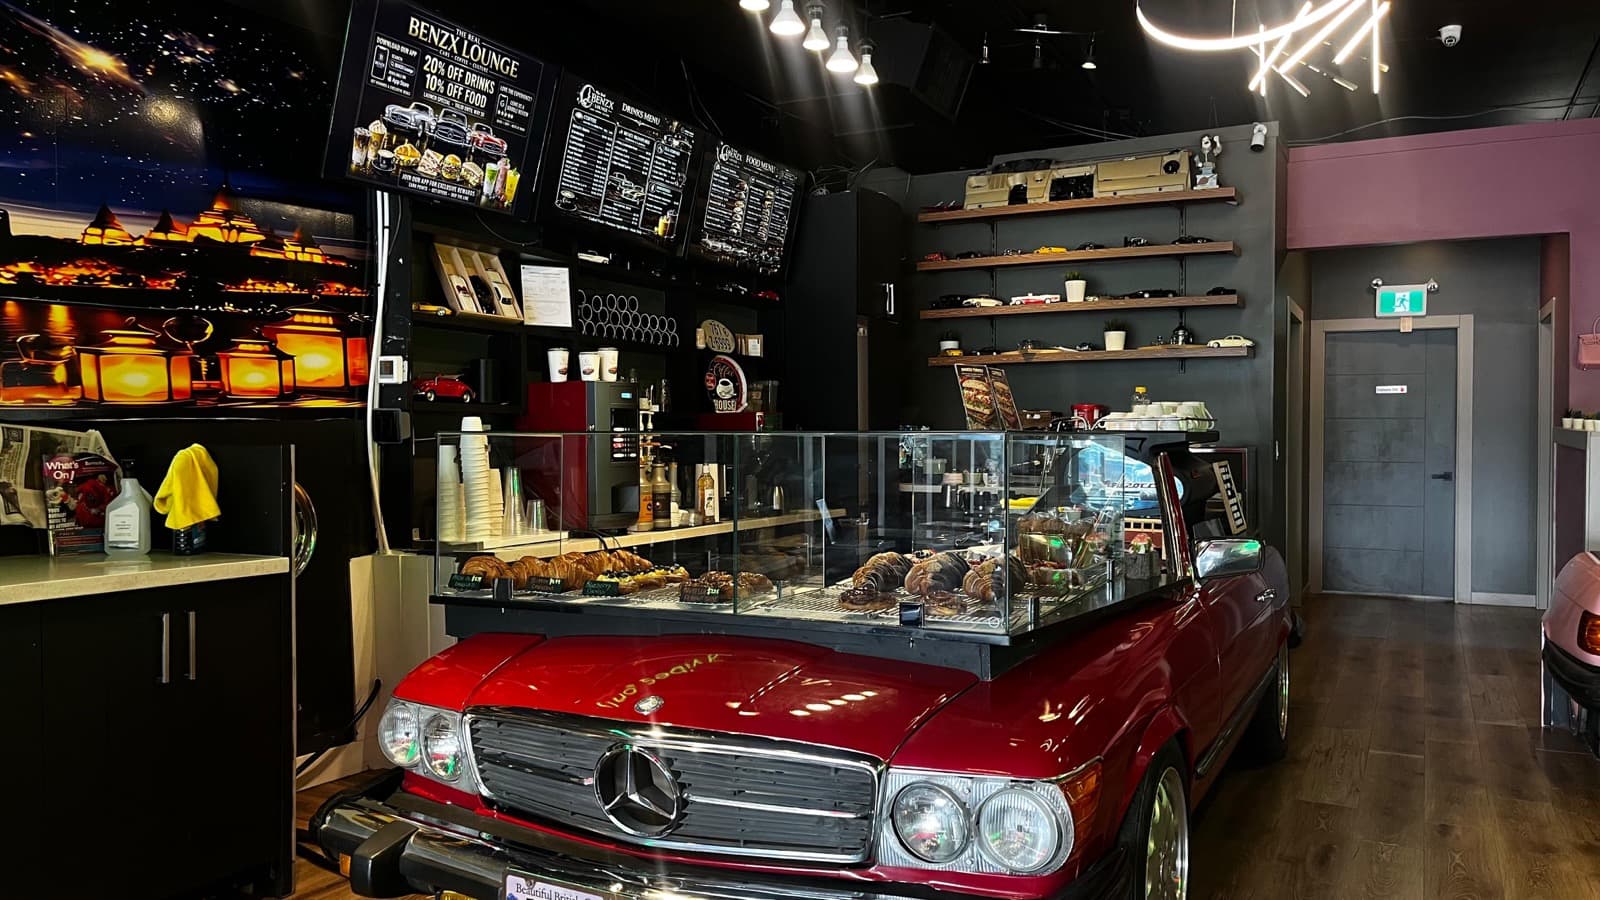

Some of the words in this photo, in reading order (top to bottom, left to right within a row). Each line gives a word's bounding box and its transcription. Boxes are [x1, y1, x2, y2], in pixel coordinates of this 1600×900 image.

[456, 28, 467, 39] THE
[467, 33, 481, 44] REAL
[408, 16, 460, 54] BENZX
[461, 40, 520, 78] LOUNGE
[423, 54, 446, 76] 20%
[447, 64, 465, 82] OFF
[465, 71, 496, 94] DRINKS
[425, 73, 445, 93] 10%
[446, 82, 464, 100] OFF
[464, 88, 487, 108] FOOD
[591, 92, 615, 110] BENZX
[621, 102, 644, 119] DRINKS
[643, 111, 661, 126] MENU
[745, 154, 761, 168] FOOD
[760, 160, 776, 174] MENU
[46, 461, 79, 470] What's
[516, 883, 553, 900] Beautiful
